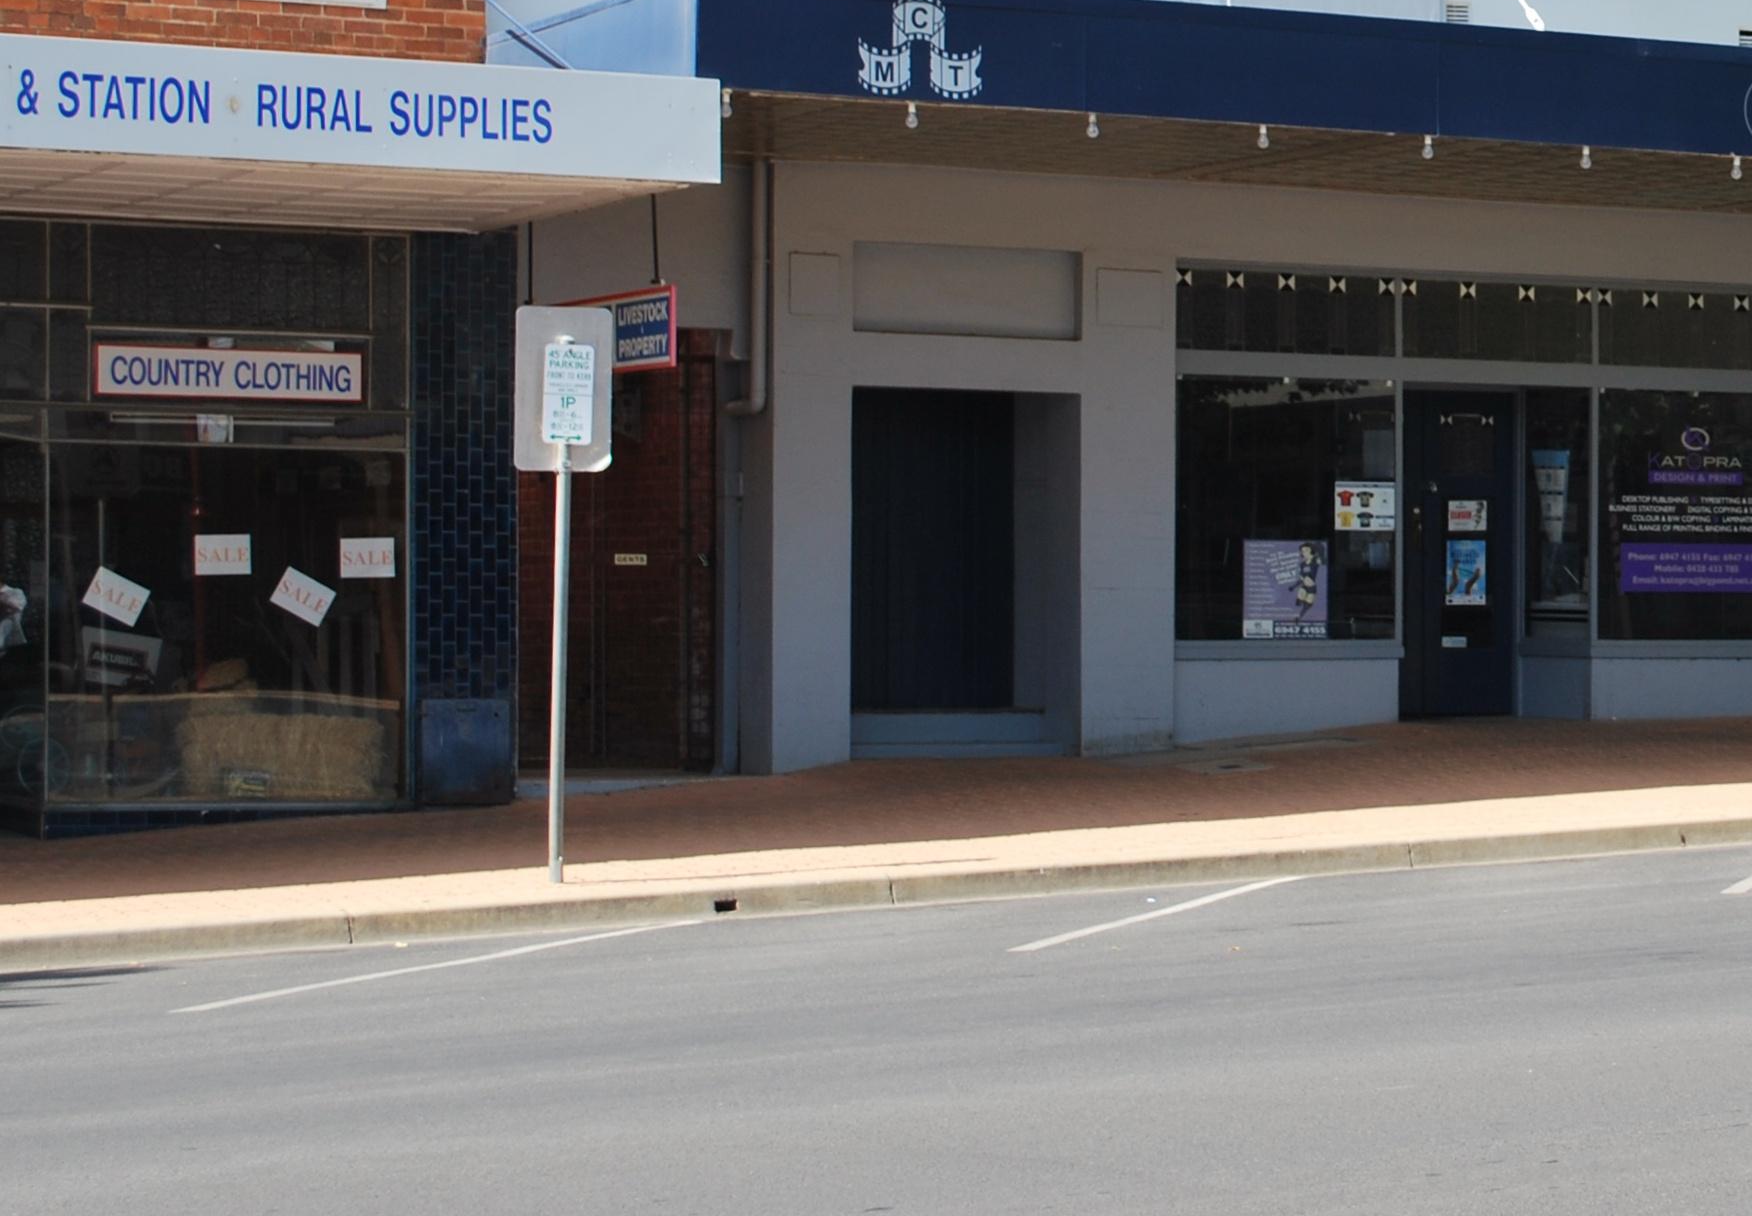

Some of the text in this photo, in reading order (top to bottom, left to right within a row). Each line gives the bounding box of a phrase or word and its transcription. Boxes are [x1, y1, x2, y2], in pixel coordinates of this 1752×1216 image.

[16, 69, 553, 143] & STATION RURAL SUPPLIES
[617, 300, 669, 326] LIVESTOCK
[563, 350, 592, 361] ANGLE
[618, 333, 668, 359] PROPERTY
[111, 356, 351, 393] COUNTRY CLOTHING
[549, 359, 590, 370] PARKING
[560, 396, 577, 409] 1P
[1648, 451, 1742, 469] KATOPRA
[198, 545, 249, 563] SALE
[342, 550, 394, 566] SALE
[91, 578, 142, 613] SALE
[278, 579, 326, 614] SALE
